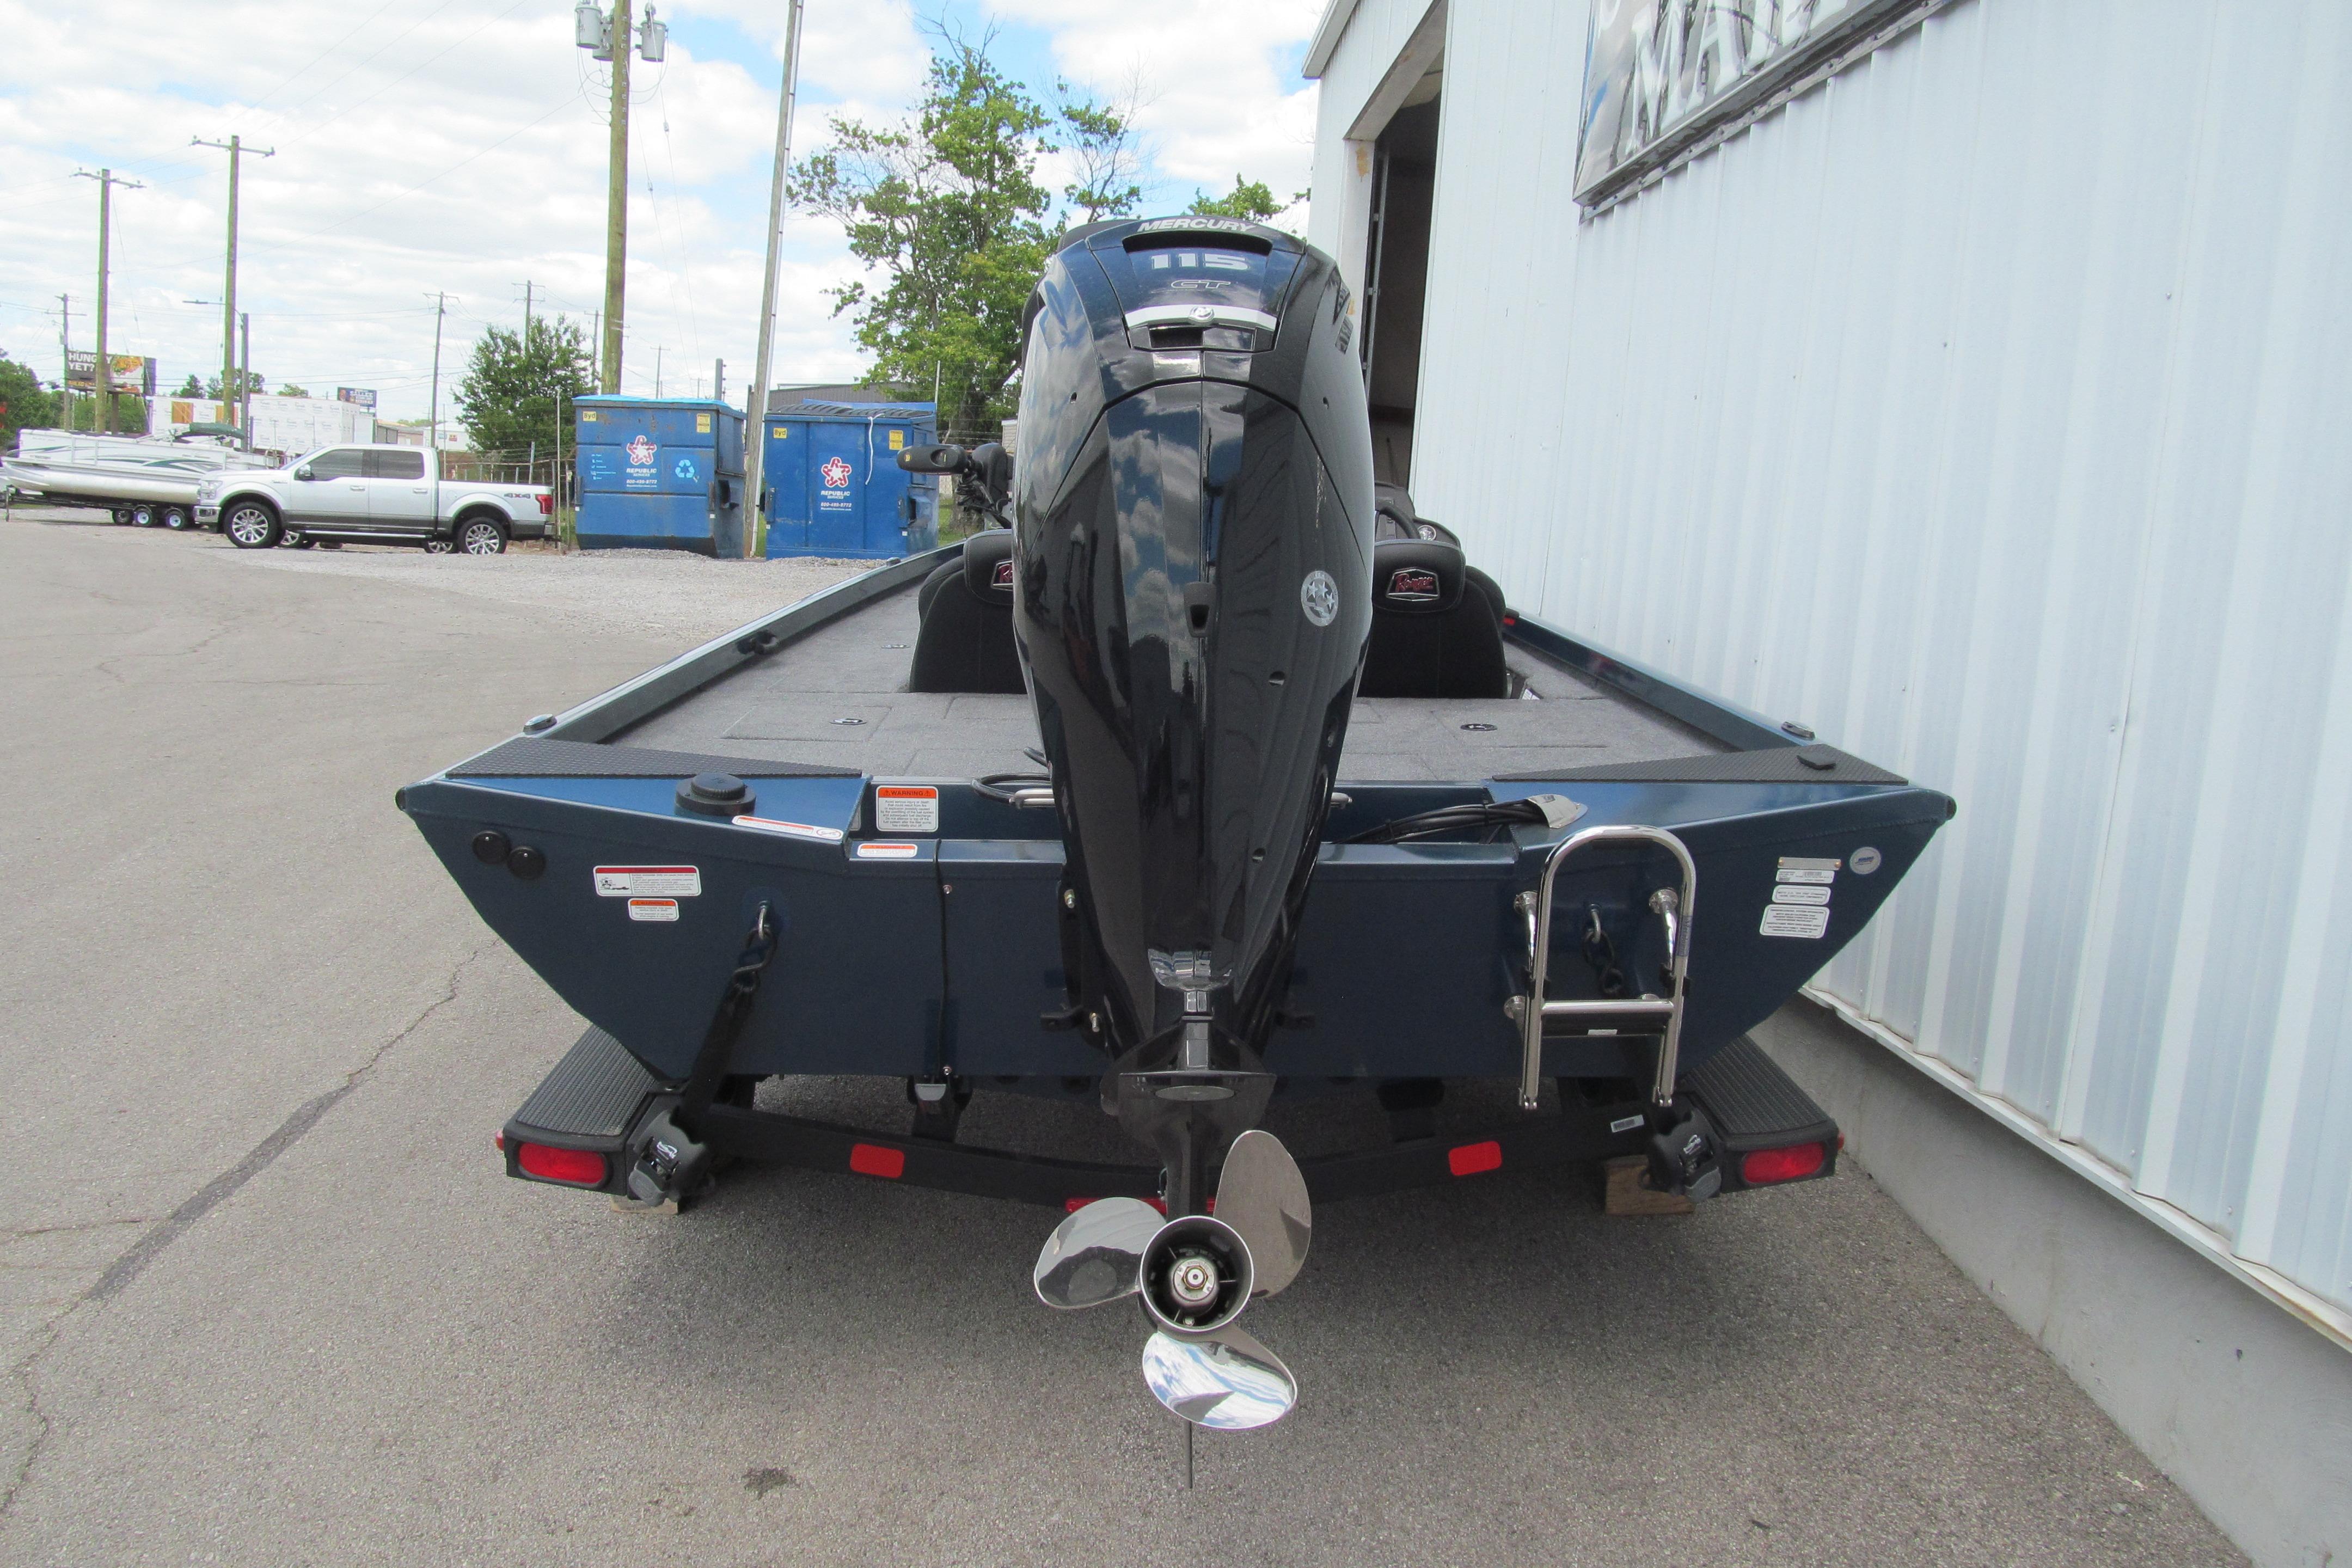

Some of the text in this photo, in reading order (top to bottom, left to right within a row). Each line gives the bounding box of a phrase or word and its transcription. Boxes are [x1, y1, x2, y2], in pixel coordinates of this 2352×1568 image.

[1137, 218, 1256, 231] MERCURY
[1151, 253, 1250, 270] 115
[1171, 279, 1231, 289] GT
[69, 353, 112, 364] HUNGY
[69, 362, 95, 371] YET?
